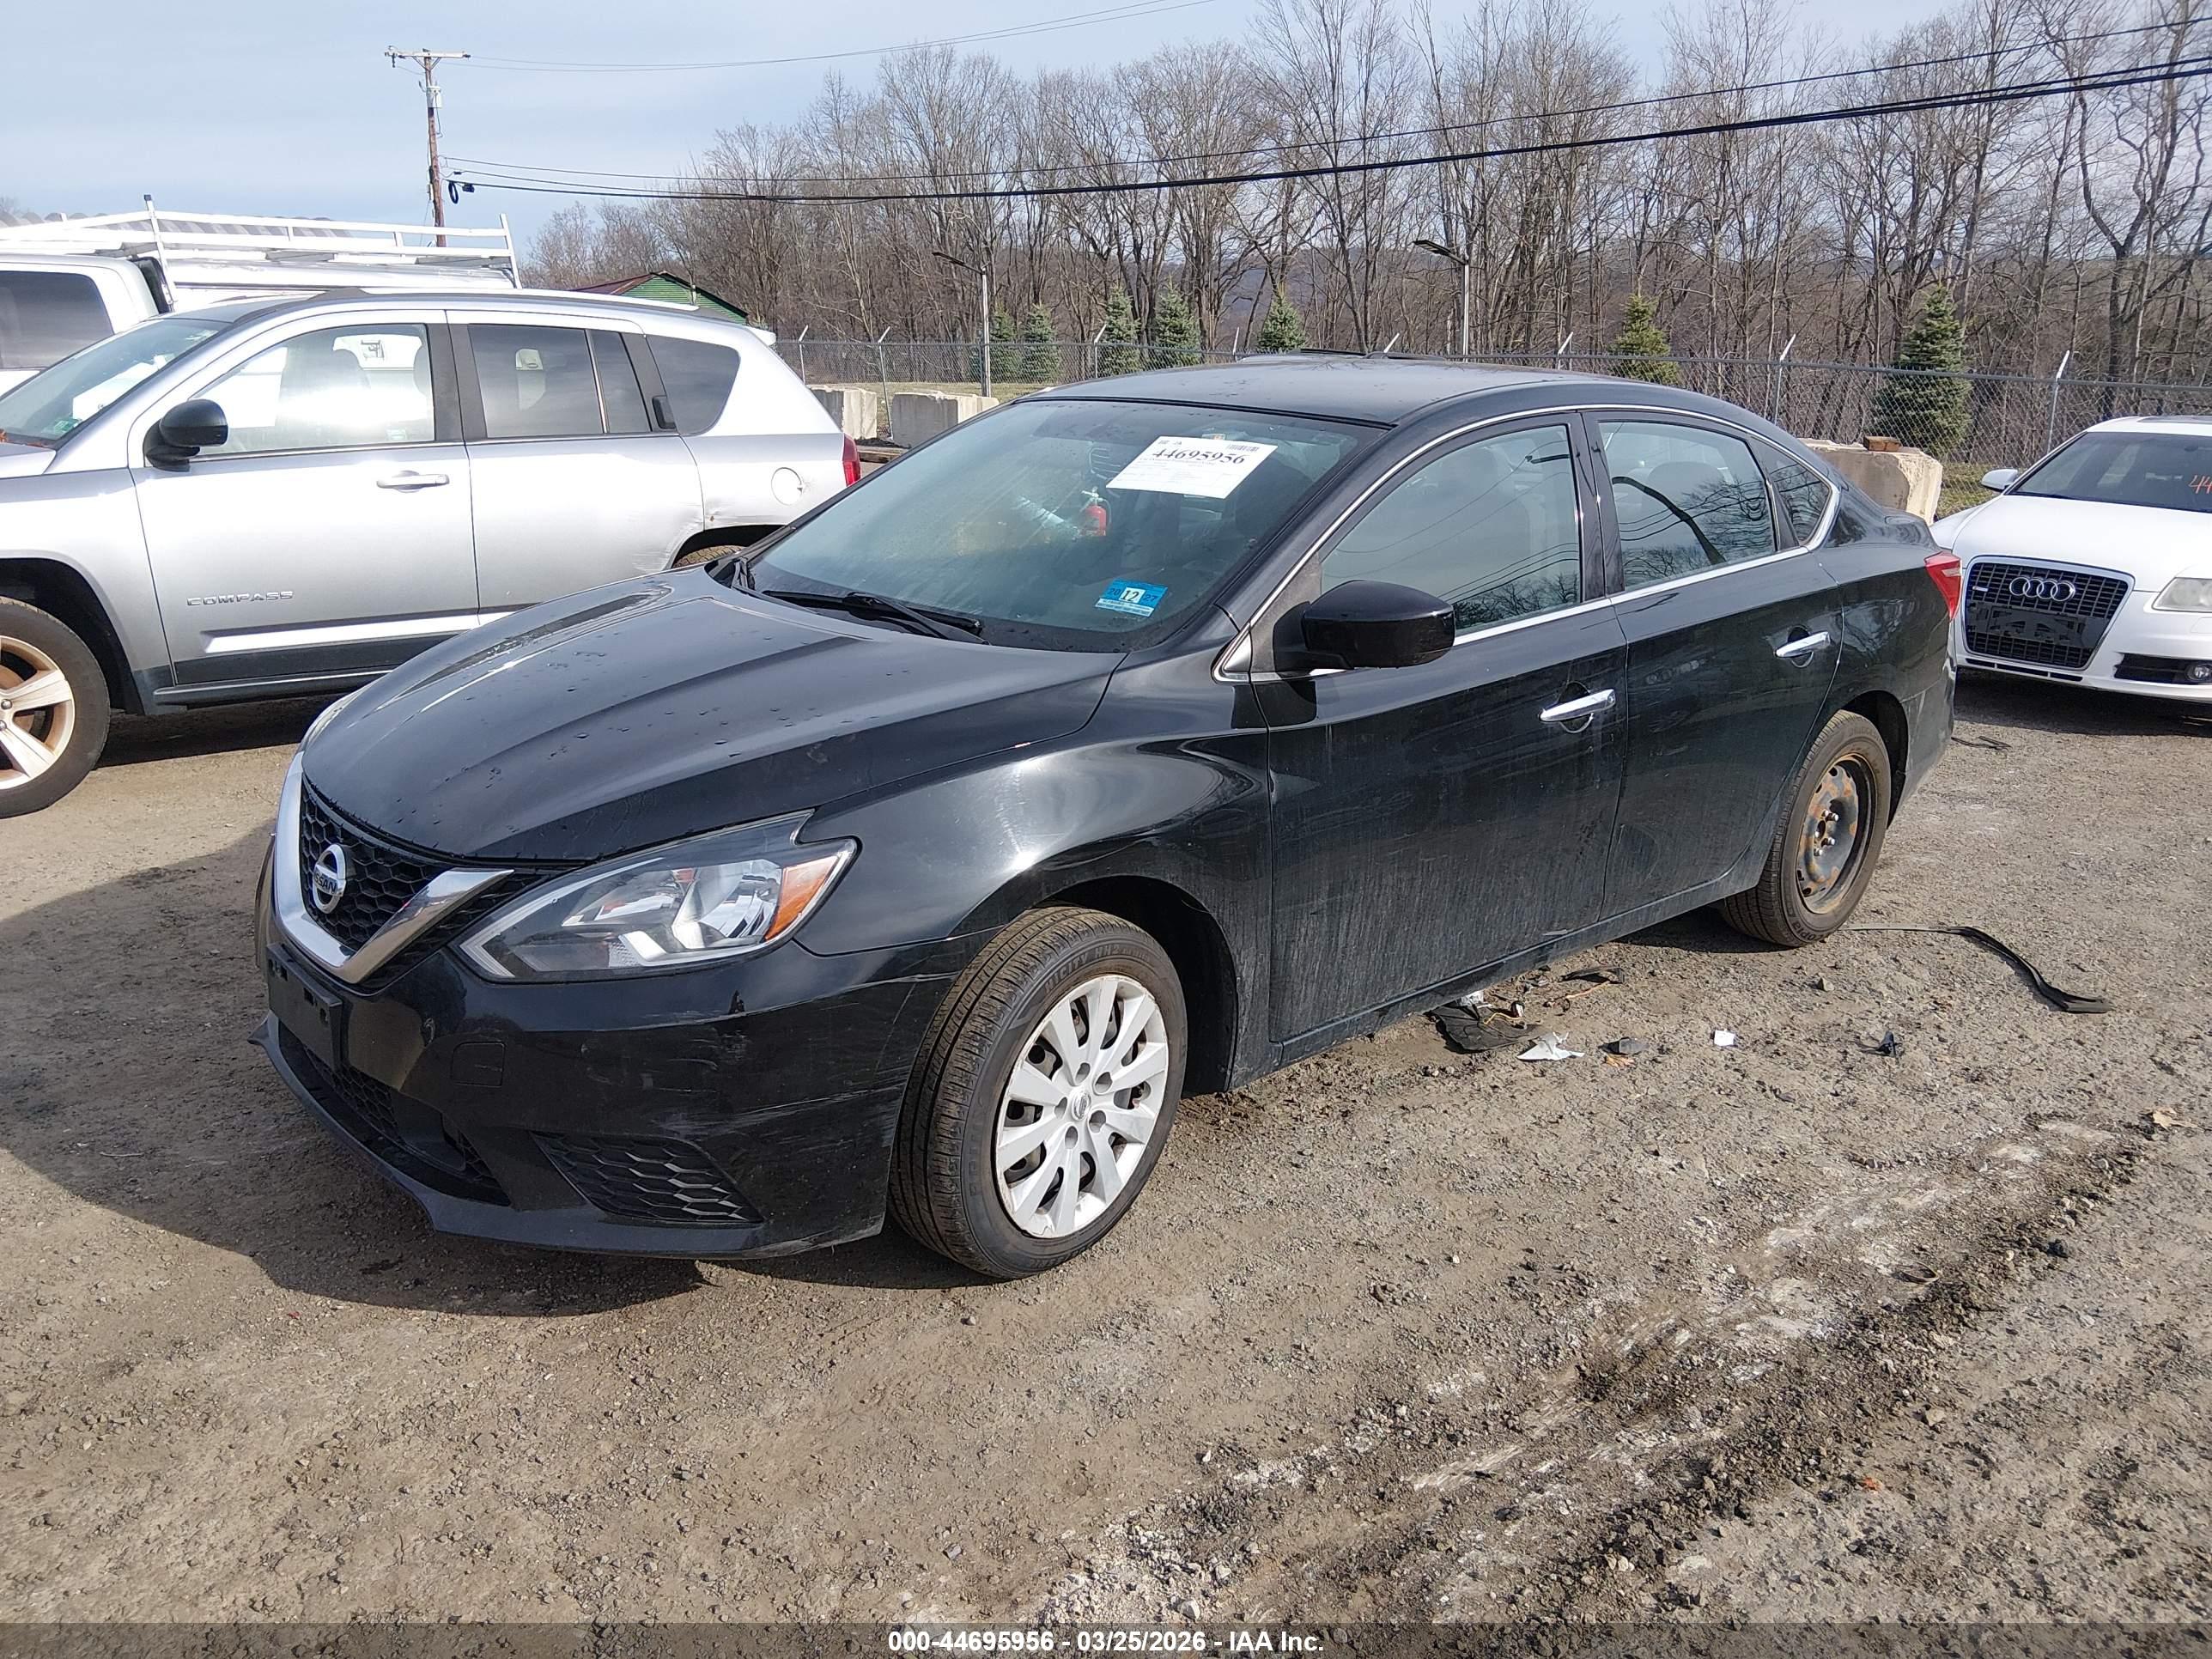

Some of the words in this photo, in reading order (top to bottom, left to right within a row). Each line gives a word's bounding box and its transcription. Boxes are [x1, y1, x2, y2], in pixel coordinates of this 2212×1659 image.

[1152, 448, 1249, 465] 44695956
[186, 590, 294, 606] COMPASS
[1107, 587, 1121, 596] 20
[1121, 589, 1139, 602] 12
